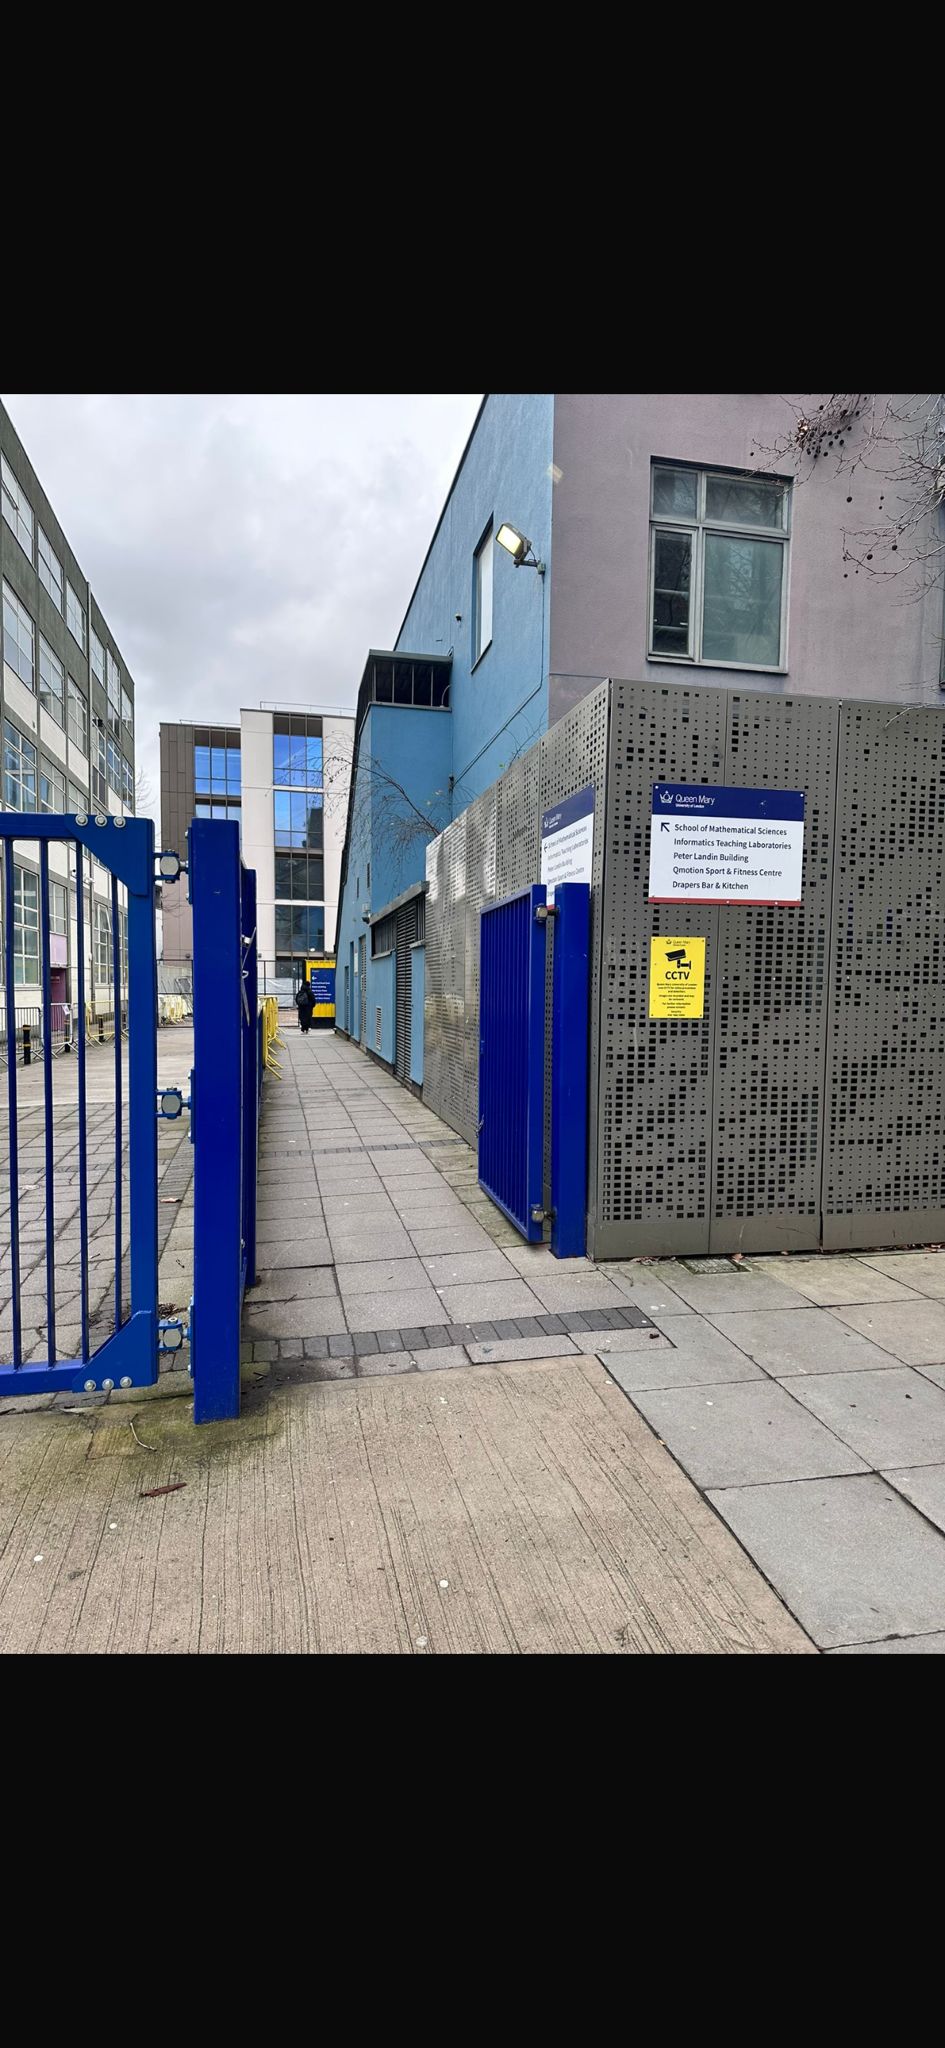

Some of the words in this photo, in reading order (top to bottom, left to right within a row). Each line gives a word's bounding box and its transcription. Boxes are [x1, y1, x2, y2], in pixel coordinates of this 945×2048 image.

[676, 794, 697, 803] Queen
[698, 795, 715, 805] Mary
[709, 826, 756, 834] Mathematical
[674, 838, 714, 846] Informatics
[716, 840, 747, 849] Teaching
[749, 841, 791, 849] Laboratories
[720, 854, 749, 863] Building
[673, 866, 704, 874] Qmotion
[706, 868, 725, 876] Sport
[673, 881, 700, 890] Drapers
[665, 971, 690, 980] CCTV
